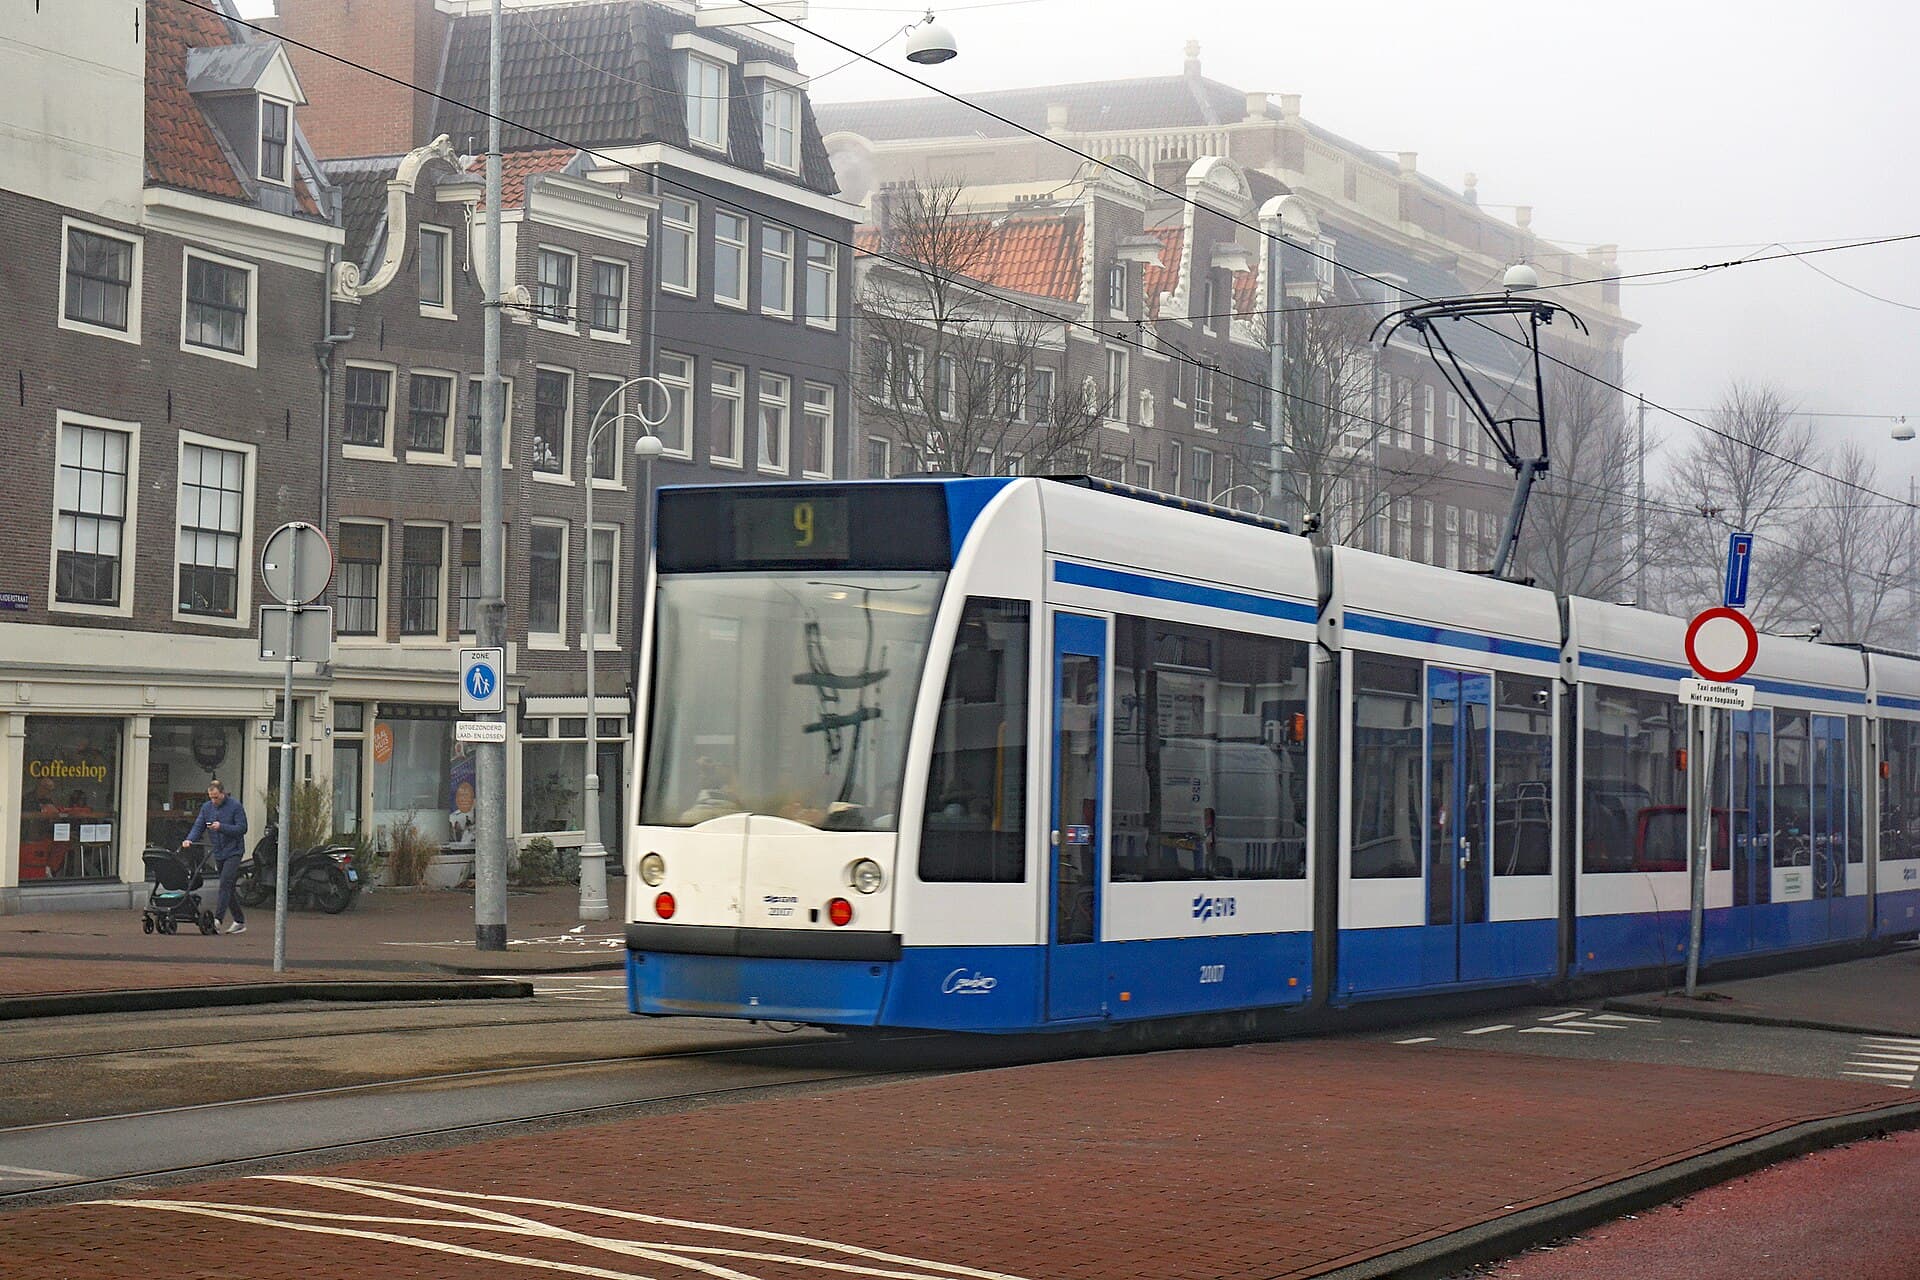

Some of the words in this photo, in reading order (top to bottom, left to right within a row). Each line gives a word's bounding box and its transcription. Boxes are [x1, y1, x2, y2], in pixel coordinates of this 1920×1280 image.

[794, 503, 814, 547] 9
[1697, 683, 1708, 691] Taxi
[1710, 685, 1738, 696] ontheffing
[1714, 696, 1745, 707] toepassing
[30, 760, 107, 782] Coffeeshop
